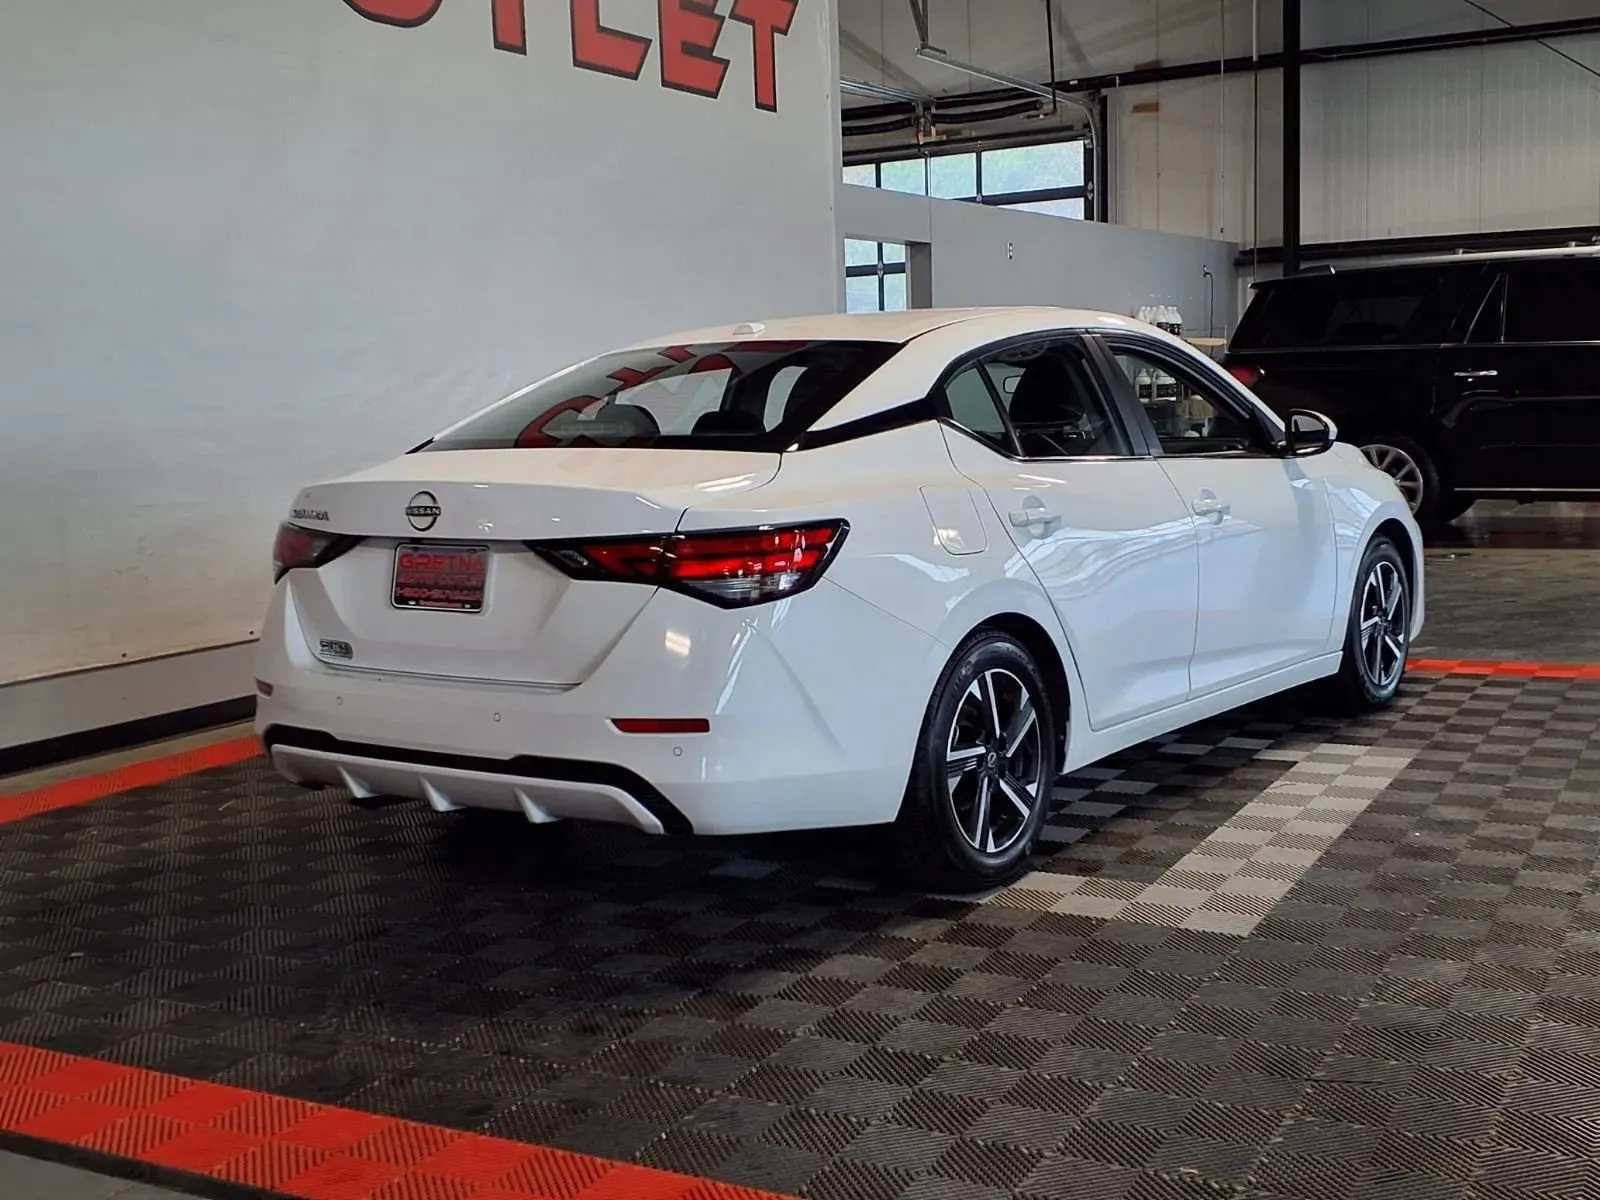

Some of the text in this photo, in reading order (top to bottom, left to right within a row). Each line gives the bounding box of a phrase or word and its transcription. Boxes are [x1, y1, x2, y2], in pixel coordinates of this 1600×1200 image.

[342, 0, 799, 113] LET
[406, 506, 441, 516] NISSAN
[400, 552, 485, 571] GRETNA
